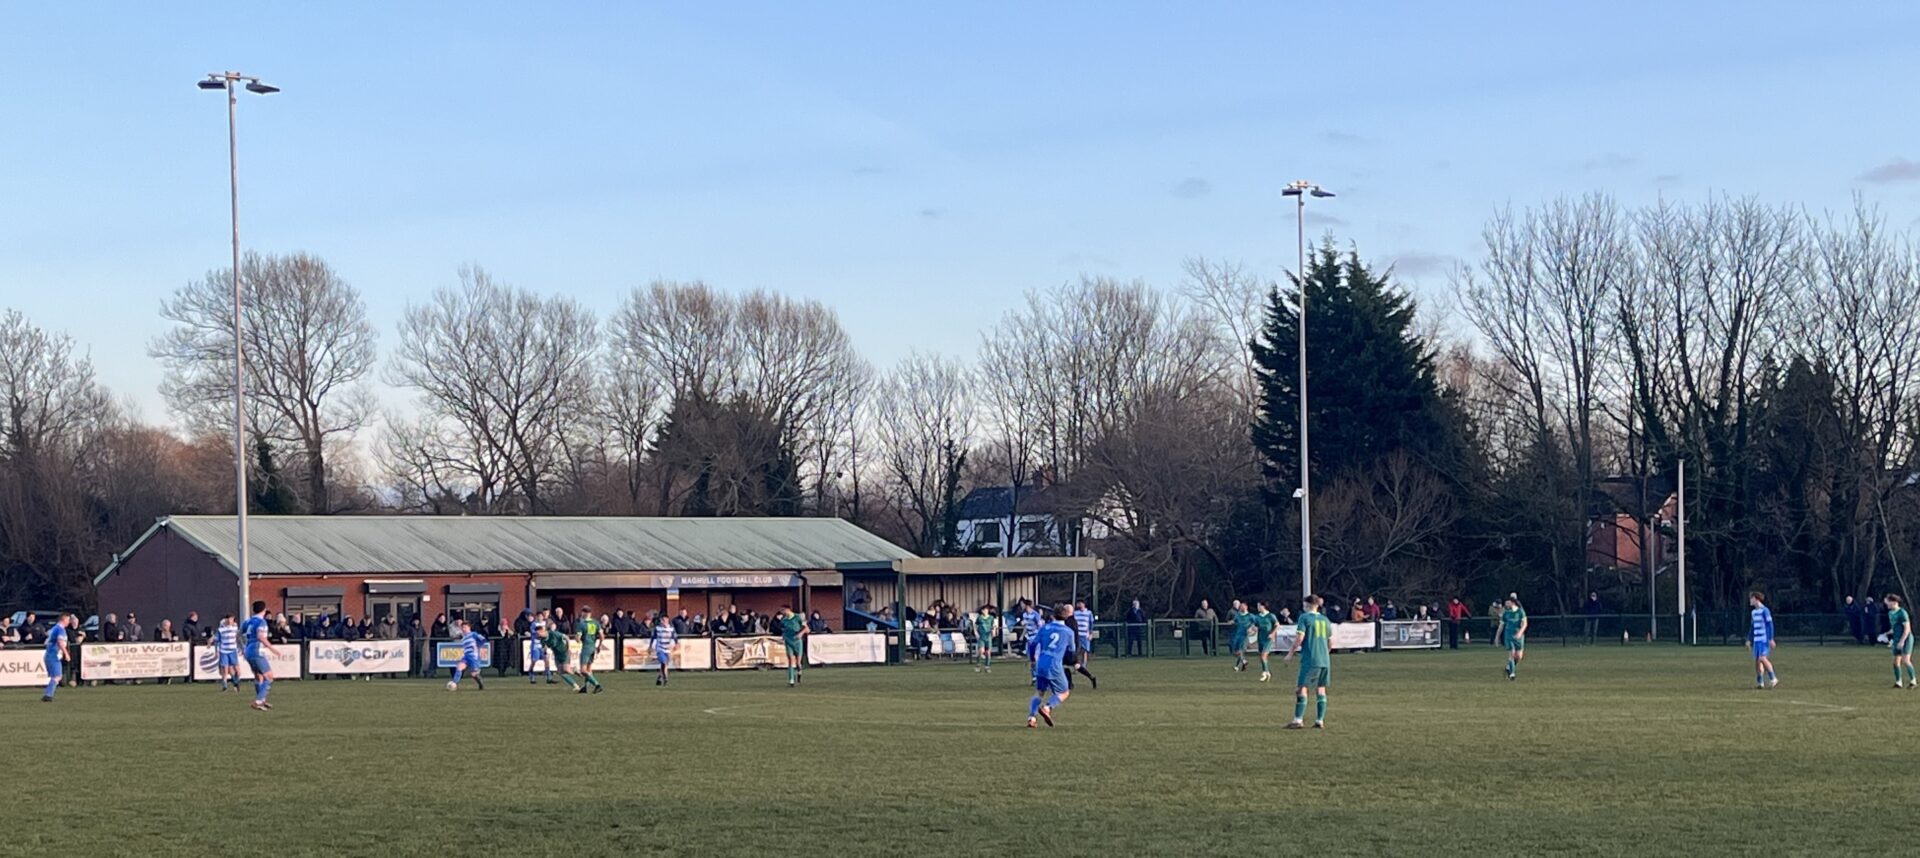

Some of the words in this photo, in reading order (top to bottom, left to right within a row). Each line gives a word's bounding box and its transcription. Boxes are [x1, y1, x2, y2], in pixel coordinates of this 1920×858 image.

[681, 576, 715, 585] MAGHULL
[717, 576, 752, 585] FOOTBALL
[753, 576, 773, 584] CLUB
[1315, 619, 1327, 639] 11
[1048, 632, 1060, 648] 2
[142, 644, 183, 653] World
